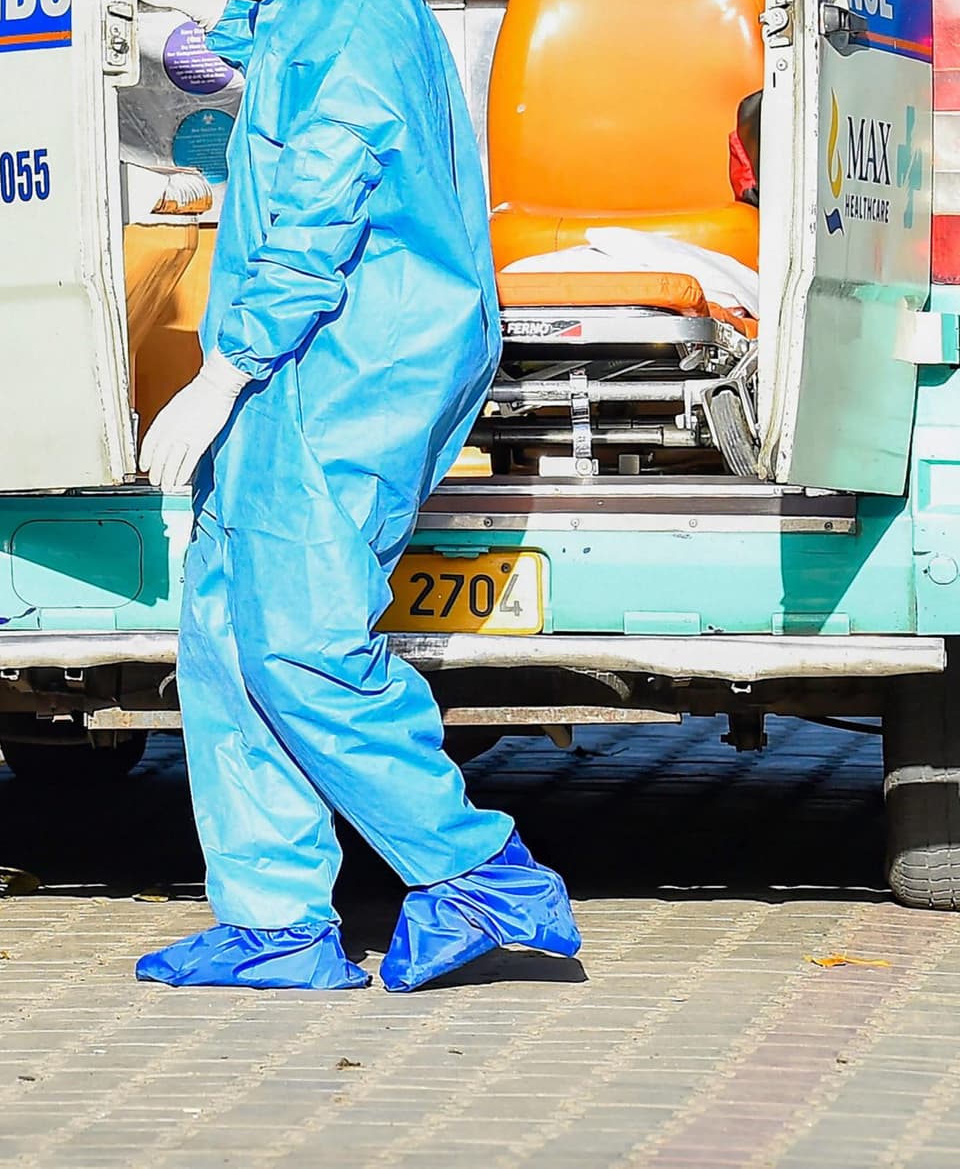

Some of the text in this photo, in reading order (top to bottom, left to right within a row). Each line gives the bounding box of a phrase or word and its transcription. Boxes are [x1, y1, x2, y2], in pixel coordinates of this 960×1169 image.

[846, 116, 891, 185] MAX
[844, 193, 890, 223] HEALTHCARE
[409, 572, 523, 617] 2704
